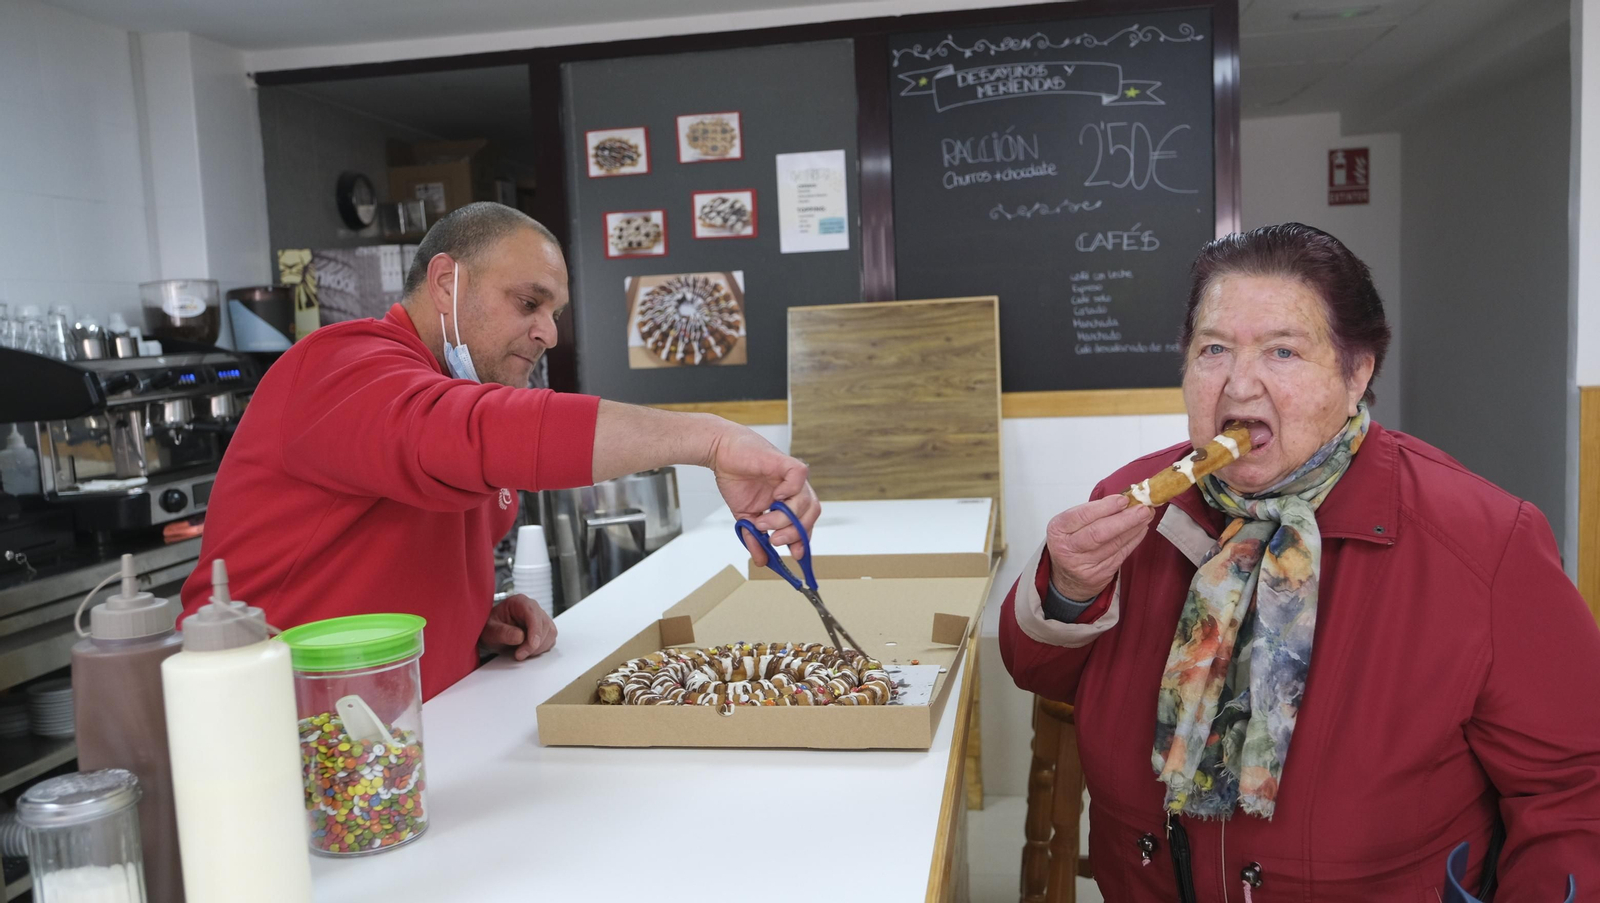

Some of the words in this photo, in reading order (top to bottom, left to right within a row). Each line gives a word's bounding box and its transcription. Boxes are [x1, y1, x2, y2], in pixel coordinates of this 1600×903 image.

[956, 64, 1049, 88] DESAYUNOS
[1063, 64, 1076, 76] Y
[976, 77, 1066, 99] MERIENDAS
[943, 171, 992, 189] Churros
[1075, 222, 1160, 252] CAFÉS
